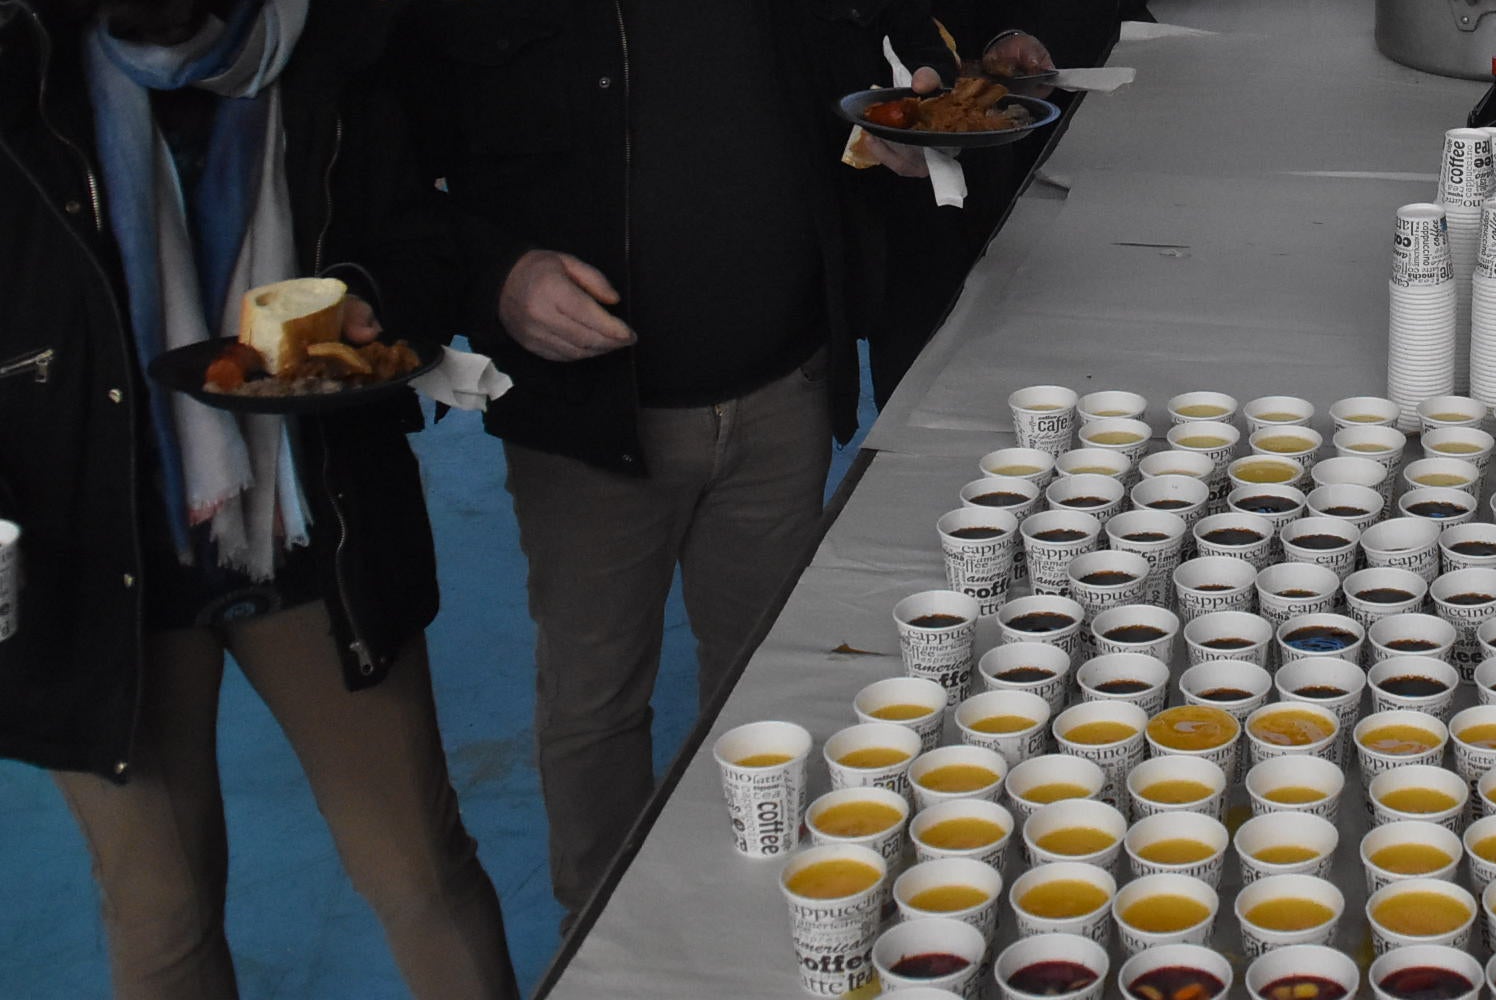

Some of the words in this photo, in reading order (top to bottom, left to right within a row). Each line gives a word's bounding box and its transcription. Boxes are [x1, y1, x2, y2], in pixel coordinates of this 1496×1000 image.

[1449, 140, 1465, 185] coffee
[1430, 219, 1439, 247] coffee
[1422, 221, 1431, 266] cappuccino
[1408, 272, 1435, 280] mocha
[1037, 416, 1068, 434] cafe
[1263, 606, 1291, 621] mocha
[1467, 753, 1496, 765] latte
[753, 774, 783, 785] latte
[756, 801, 784, 856] coffee
